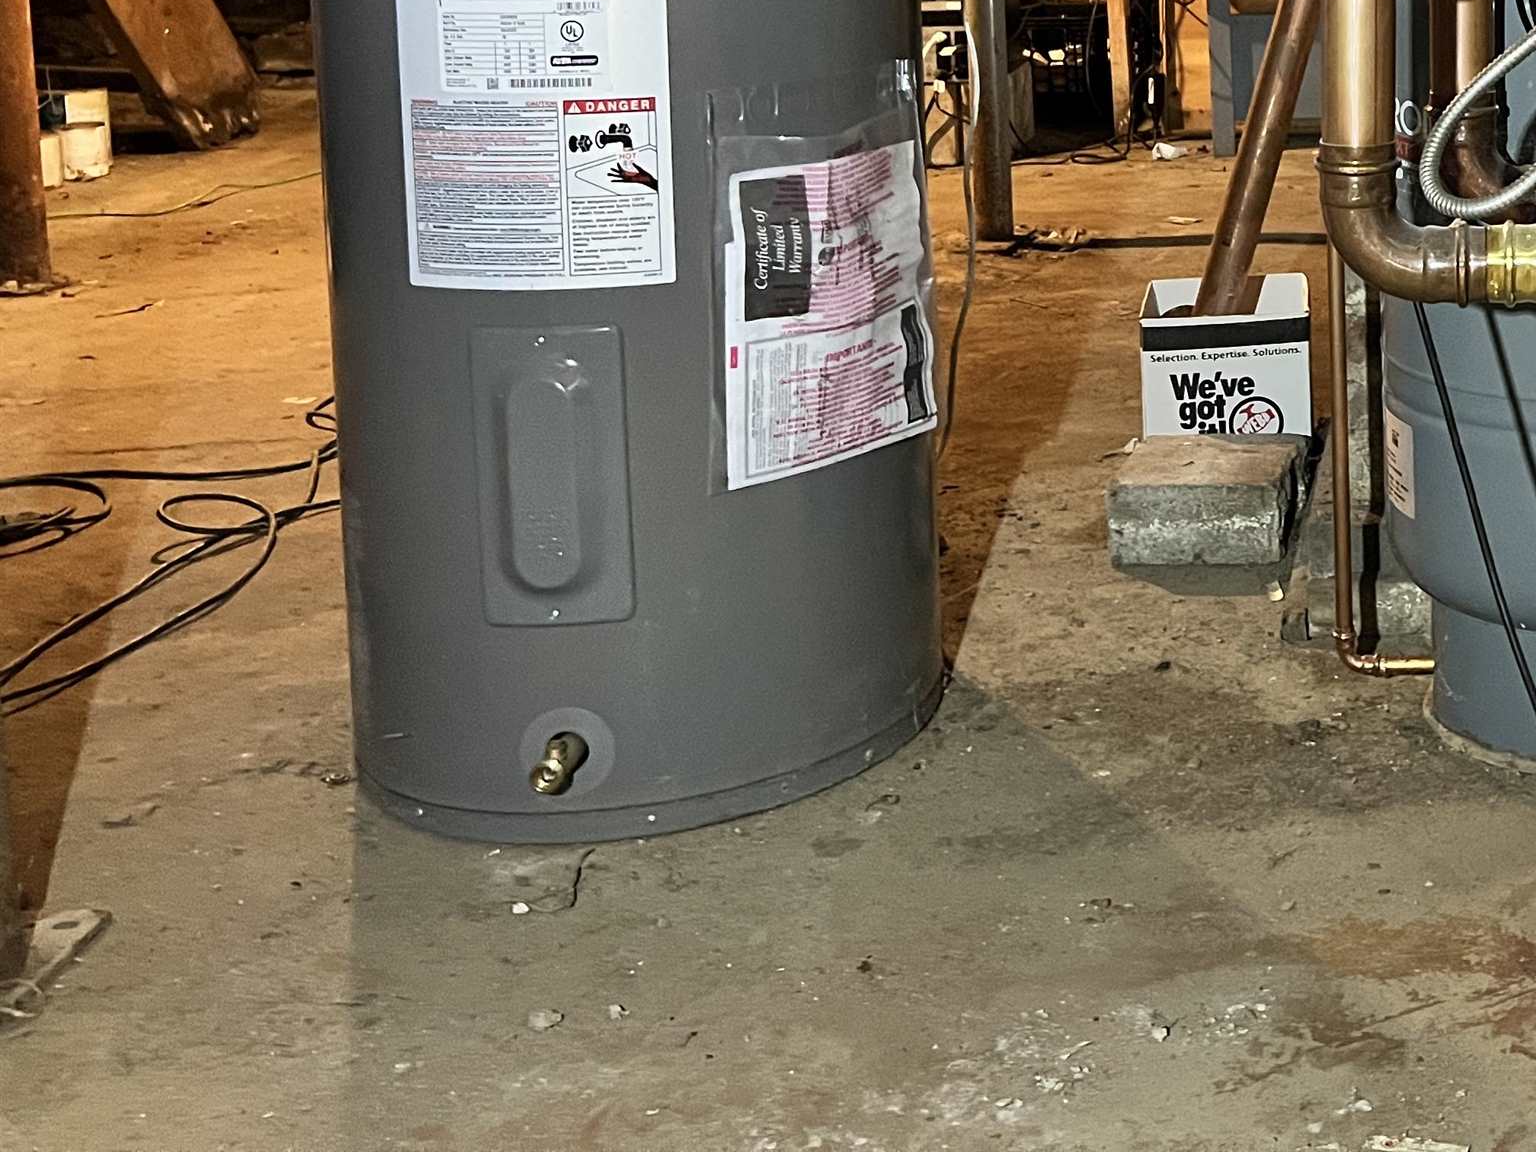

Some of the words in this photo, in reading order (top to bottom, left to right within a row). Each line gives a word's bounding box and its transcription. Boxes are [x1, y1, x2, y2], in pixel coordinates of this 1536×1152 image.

[585, 99, 650, 112] DANGER
[750, 207, 768, 222] of
[753, 224, 770, 290] Certificate
[770, 224, 786, 272] Limited
[1150, 353, 1199, 363] Selection.
[1201, 350, 1251, 362] Expertise.
[1252, 347, 1302, 357] Solutions.
[1169, 371, 1256, 401] We've
[1179, 394, 1226, 430] got
